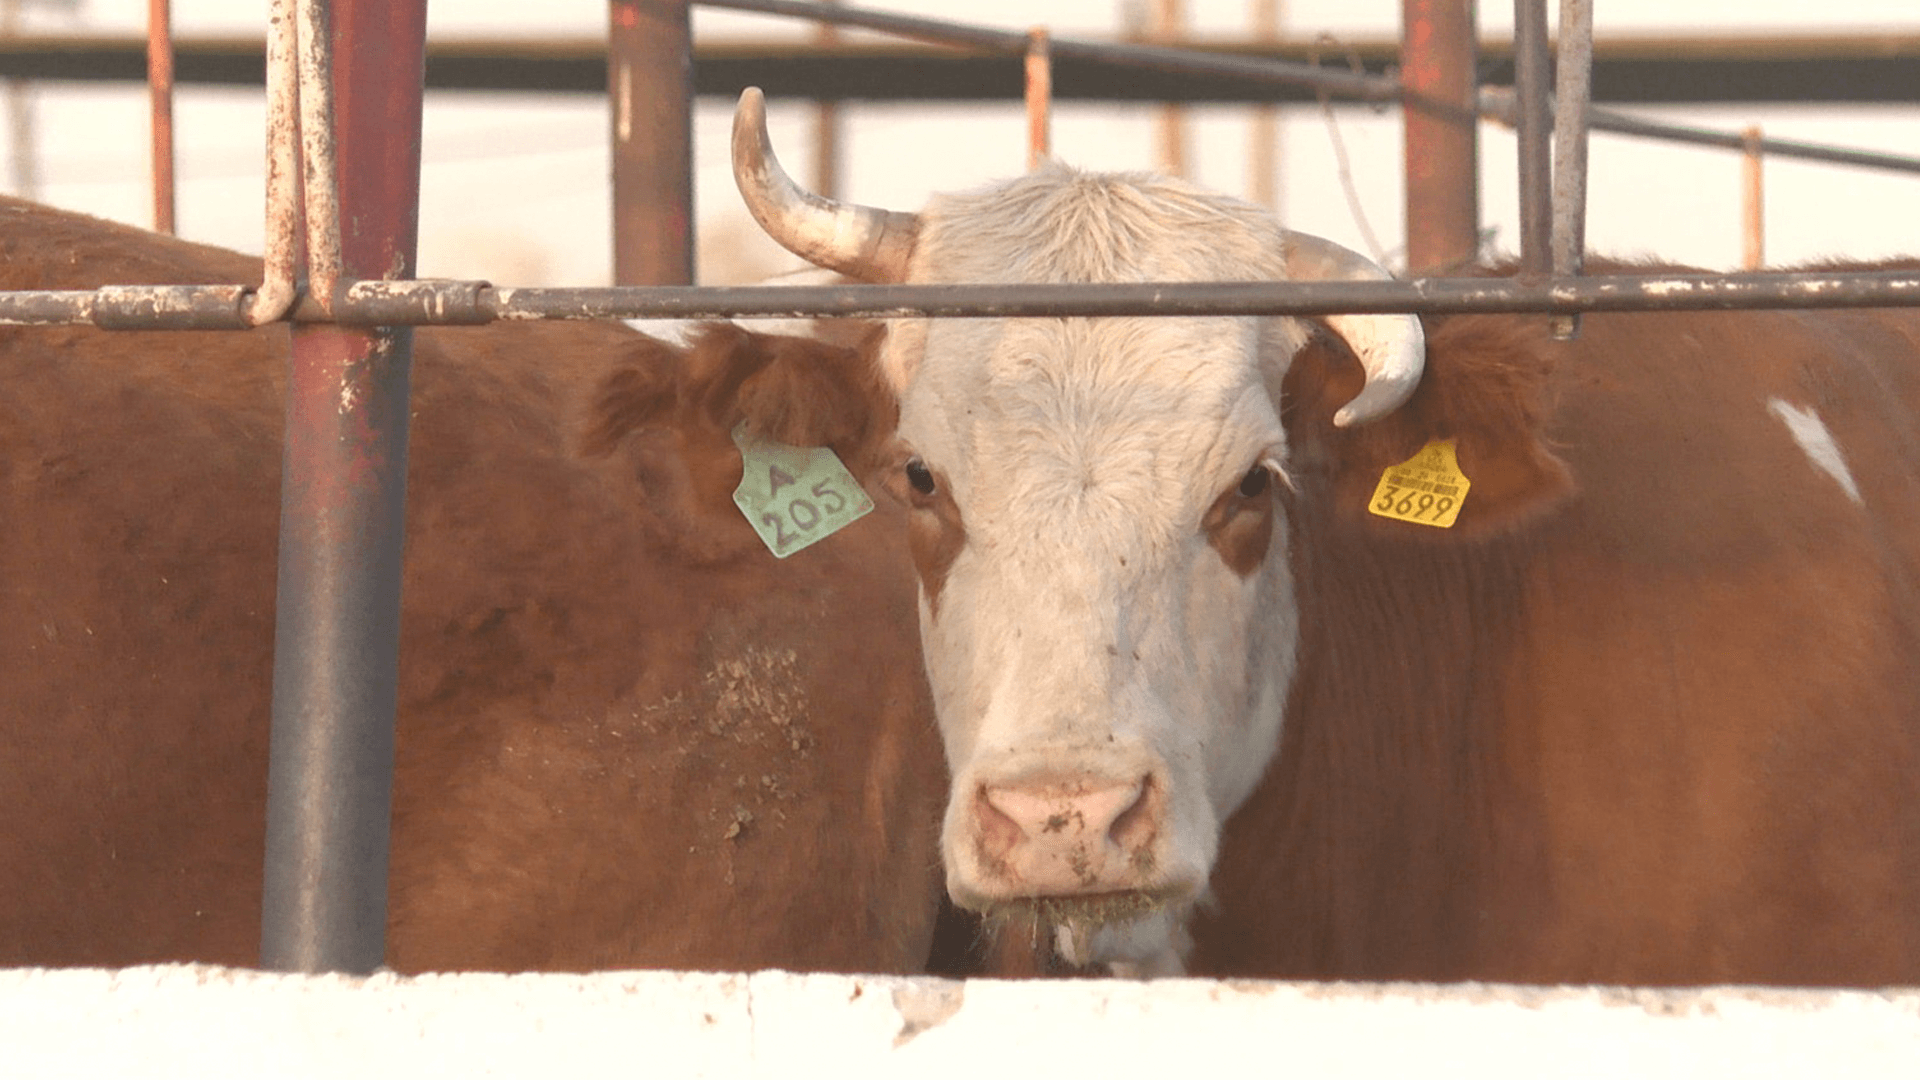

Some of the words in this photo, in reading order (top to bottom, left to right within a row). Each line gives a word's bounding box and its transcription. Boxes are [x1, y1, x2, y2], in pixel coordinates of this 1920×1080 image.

[769, 465, 795, 497] A
[762, 477, 846, 547] 205
[1376, 485, 1453, 521] 3699
